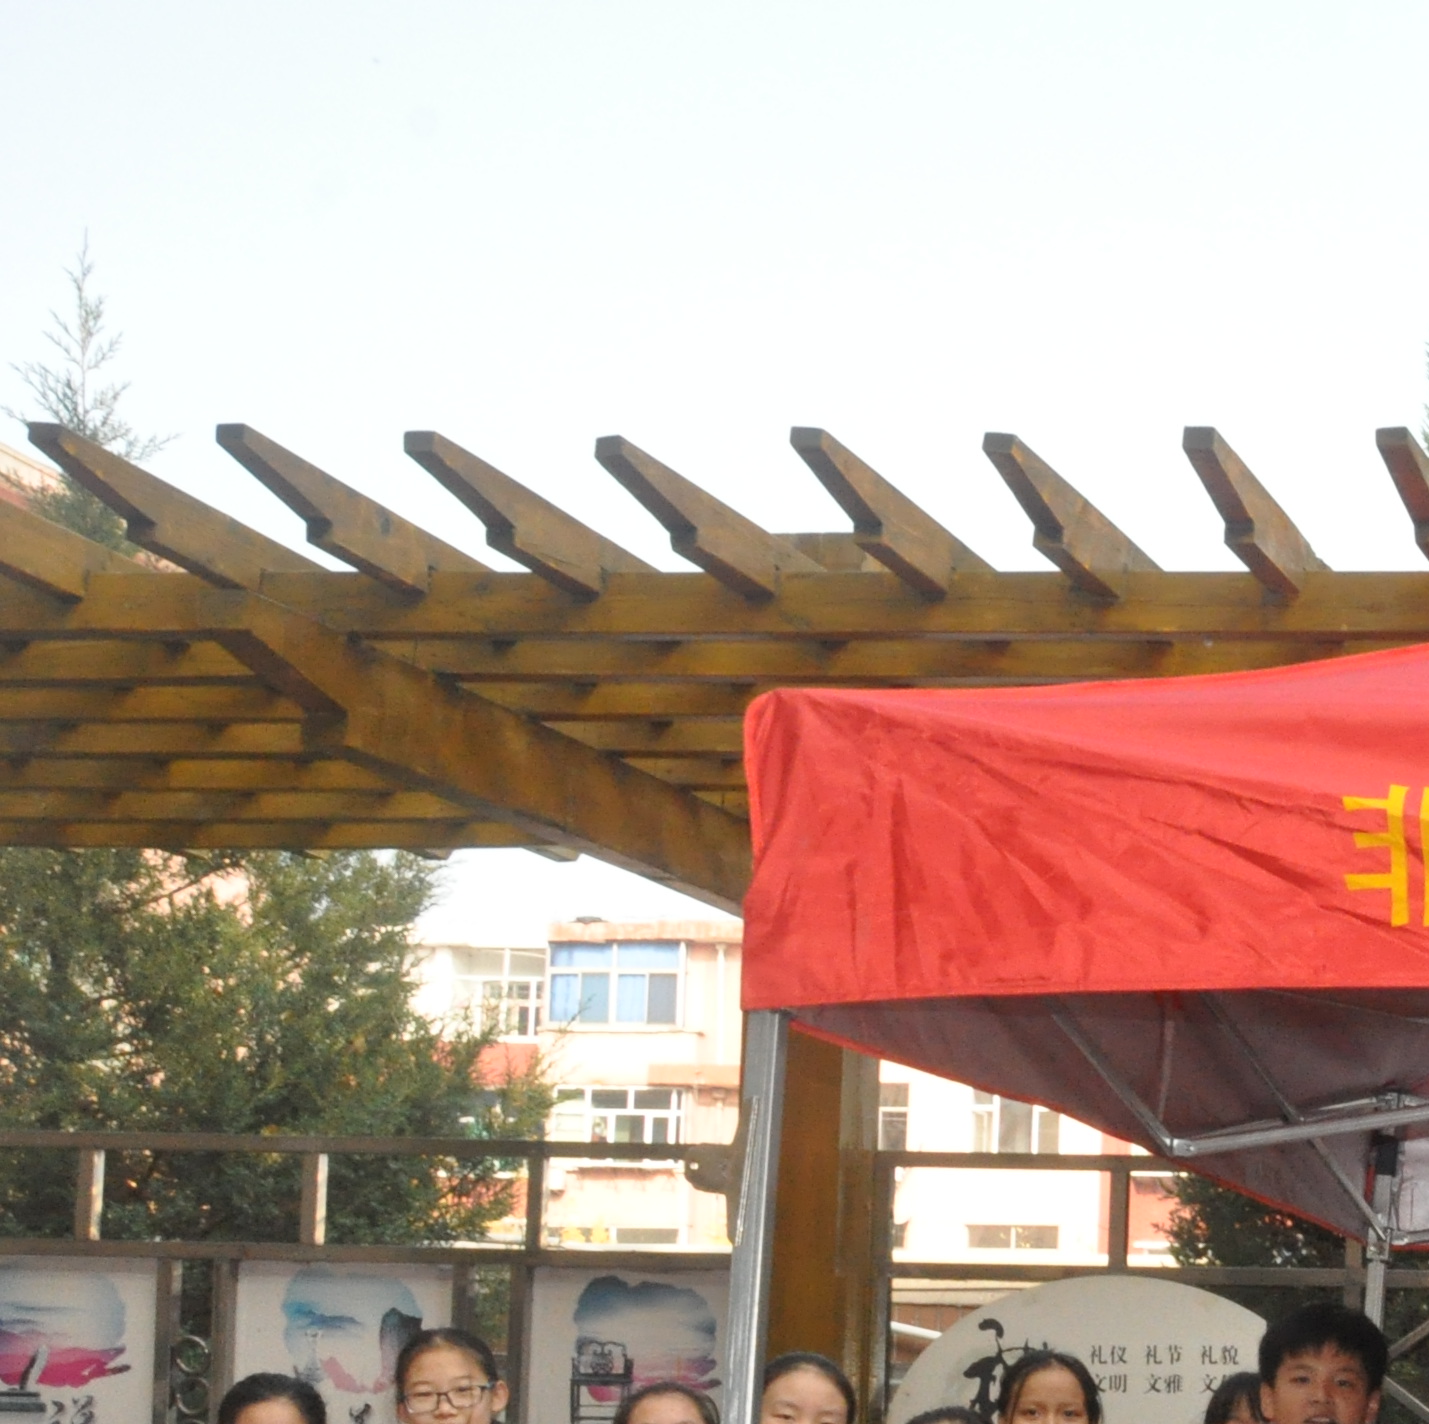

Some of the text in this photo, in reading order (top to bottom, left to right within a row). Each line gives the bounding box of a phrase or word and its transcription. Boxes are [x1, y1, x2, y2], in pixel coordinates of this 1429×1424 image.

[1090, 1344, 1240, 1366] 礼仪 礼节 礼貌
[1094, 1373, 1128, 1394] 文明
[1145, 1373, 1183, 1394] 文雅
